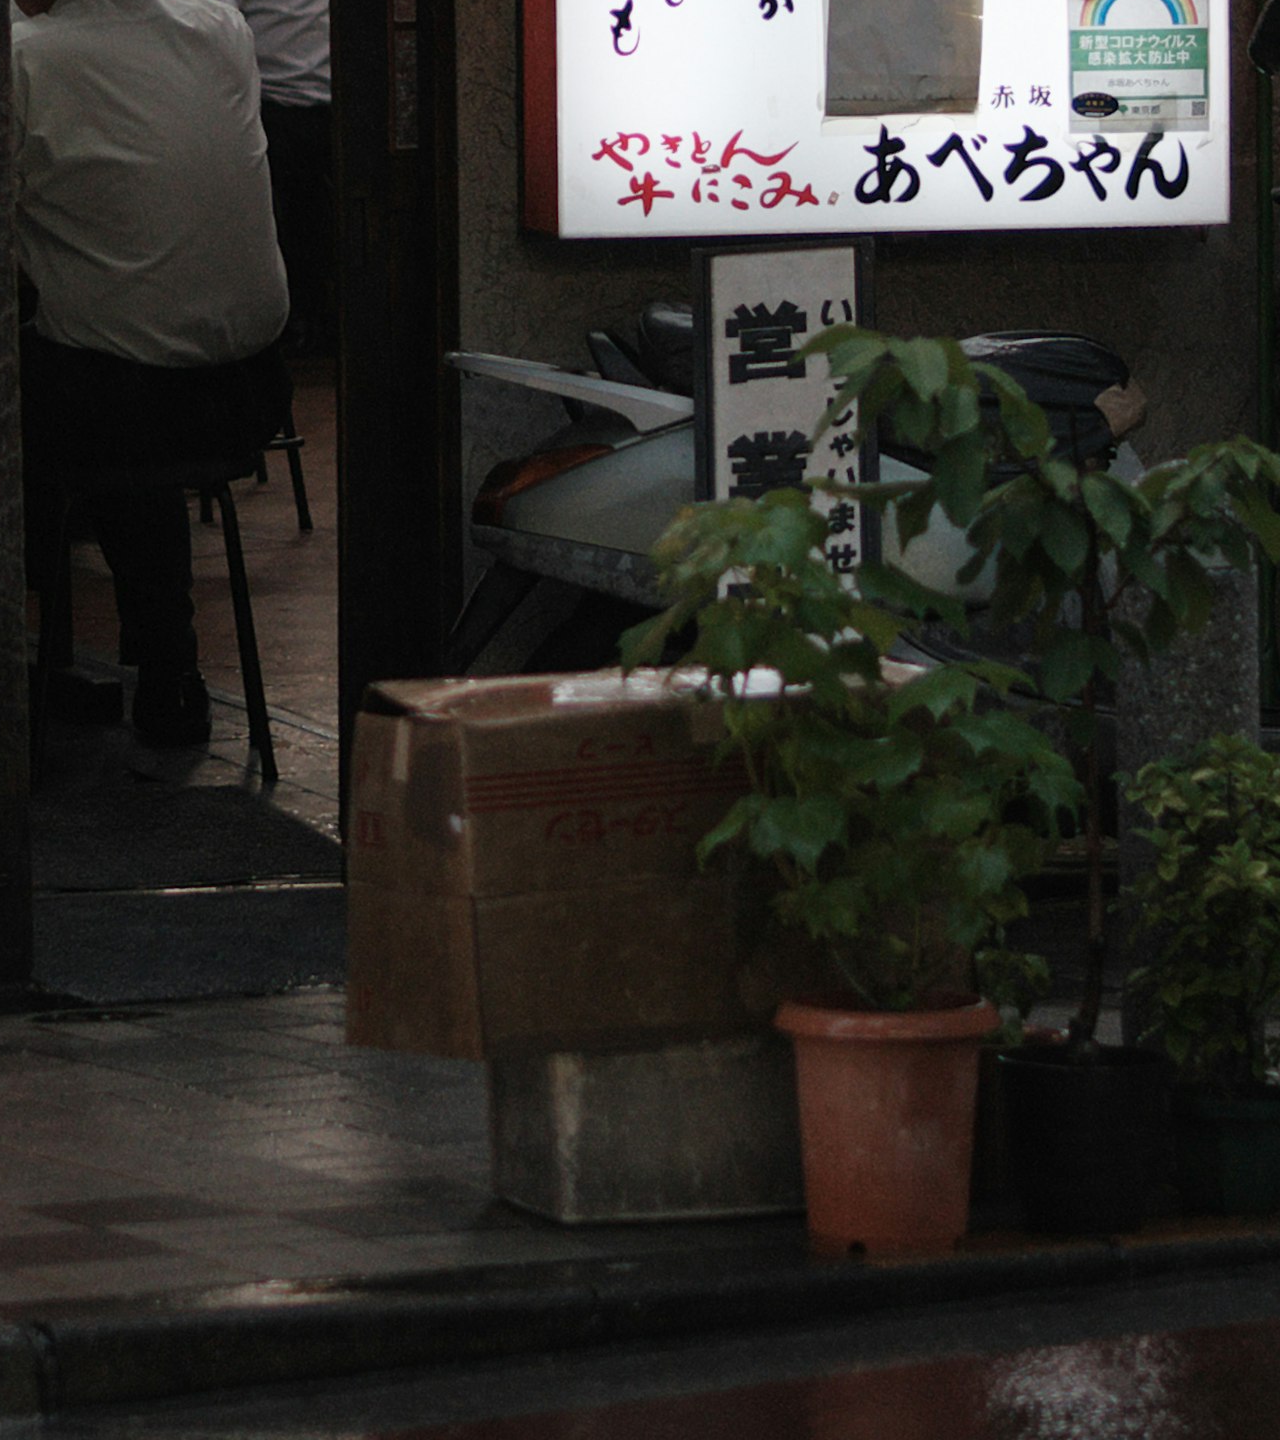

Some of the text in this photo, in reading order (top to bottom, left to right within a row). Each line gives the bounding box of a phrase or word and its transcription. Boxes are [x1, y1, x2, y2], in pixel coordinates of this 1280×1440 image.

[1079, 34, 1198, 50] 新型コロナウイルス
[1087, 50, 1190, 66] 感染拡大防止中
[991, 85, 1053, 109] 赤坂
[592, 129, 799, 172] やきとん
[854, 123, 1190, 205] あべちゃん
[617, 172, 820, 218] 牛にこみ
